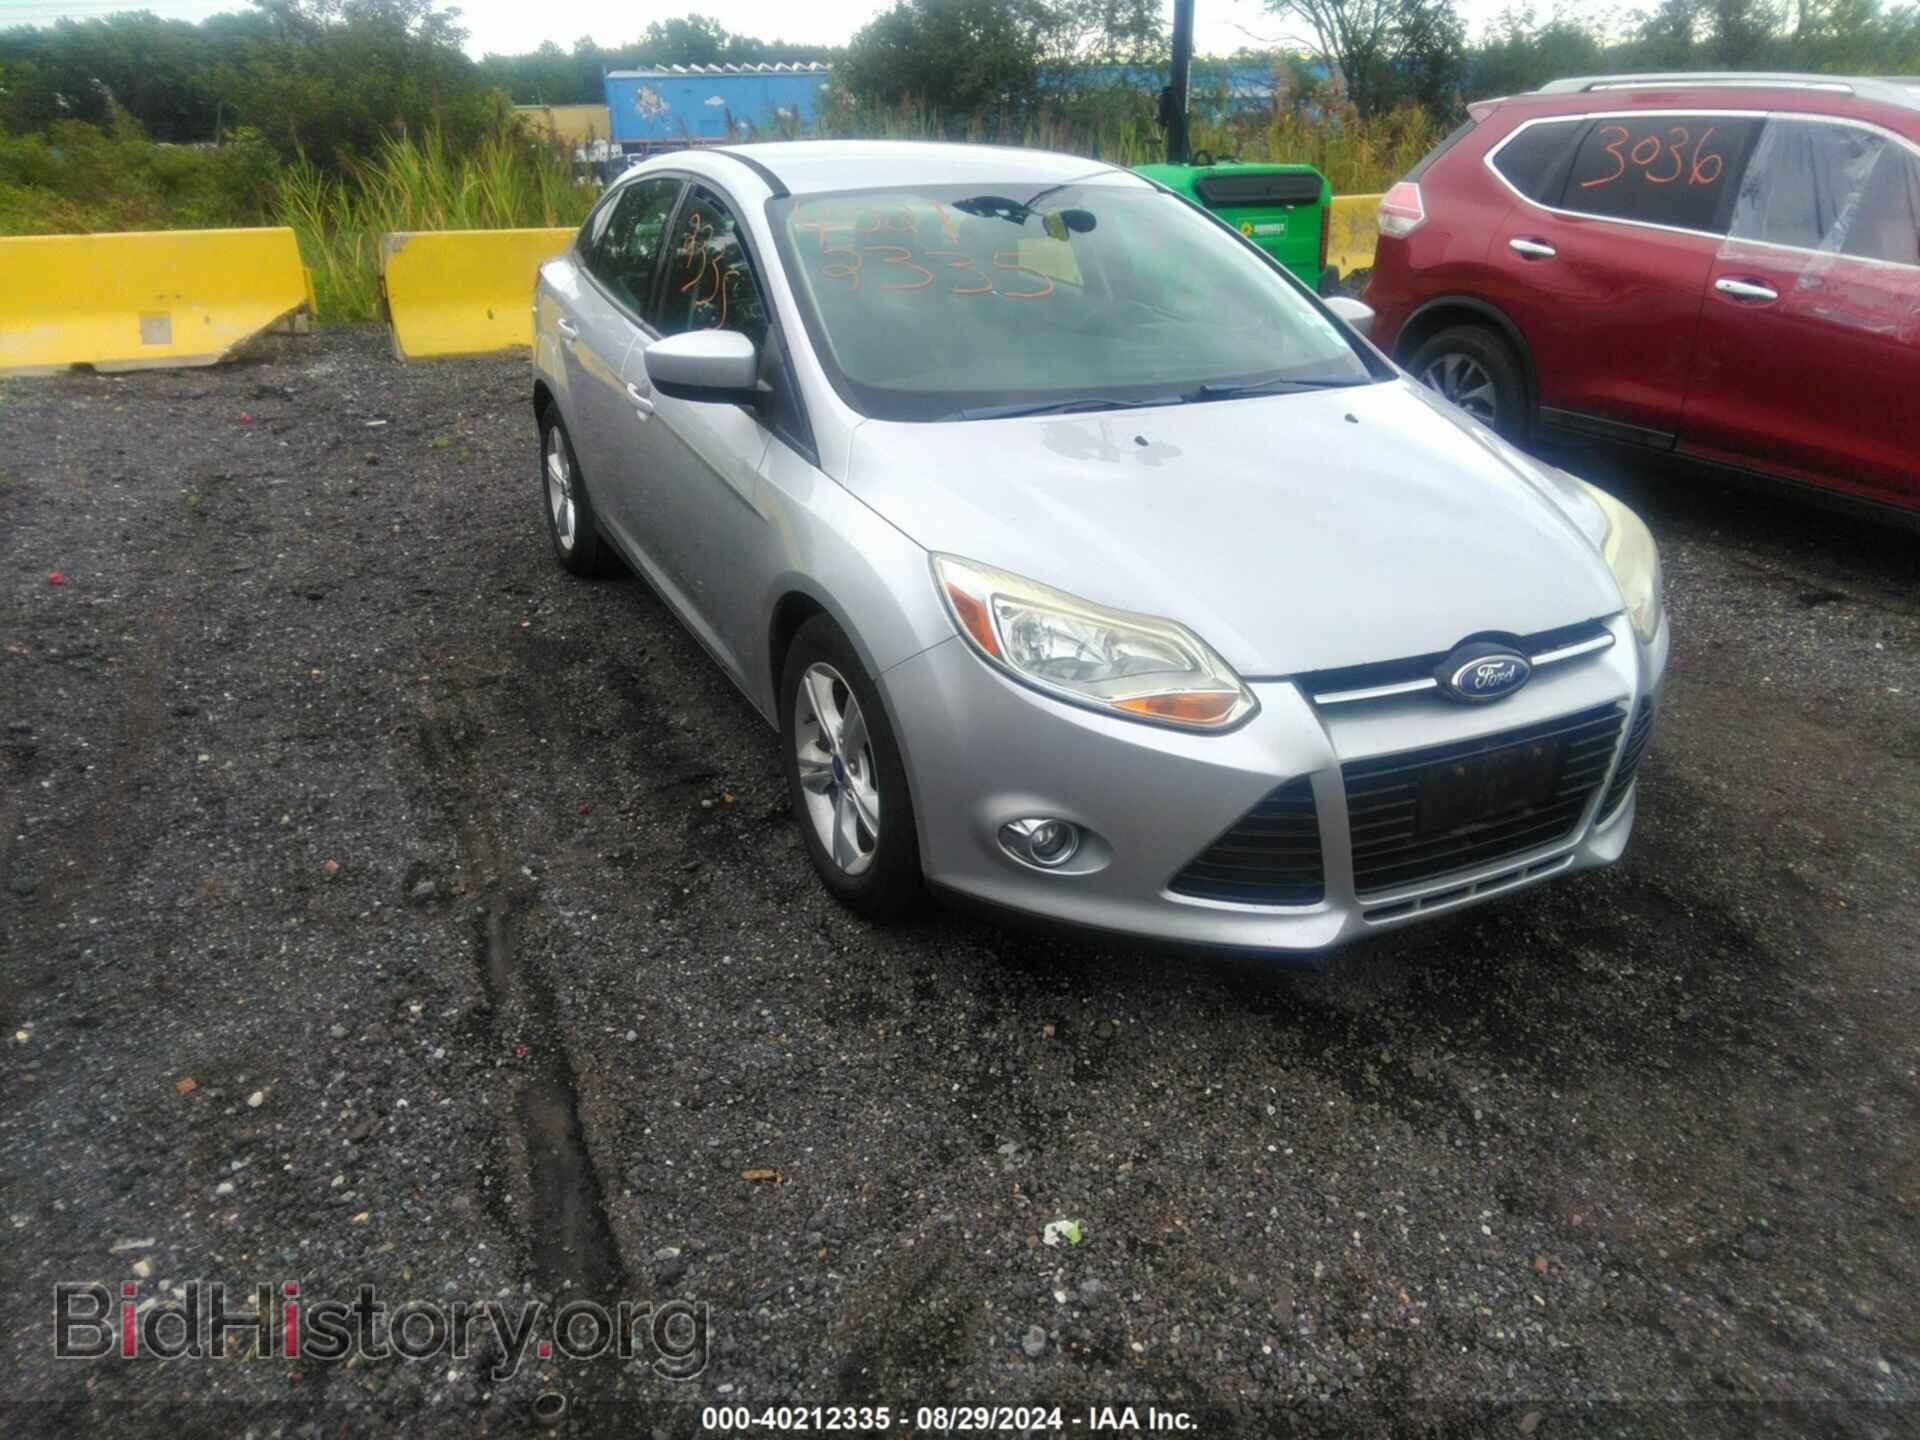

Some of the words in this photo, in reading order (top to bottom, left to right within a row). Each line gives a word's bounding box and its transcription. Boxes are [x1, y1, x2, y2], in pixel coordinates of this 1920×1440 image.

[1581, 125, 1722, 188] 3036
[820, 245, 1055, 297] 2335
[1474, 662, 1515, 689] Ford
